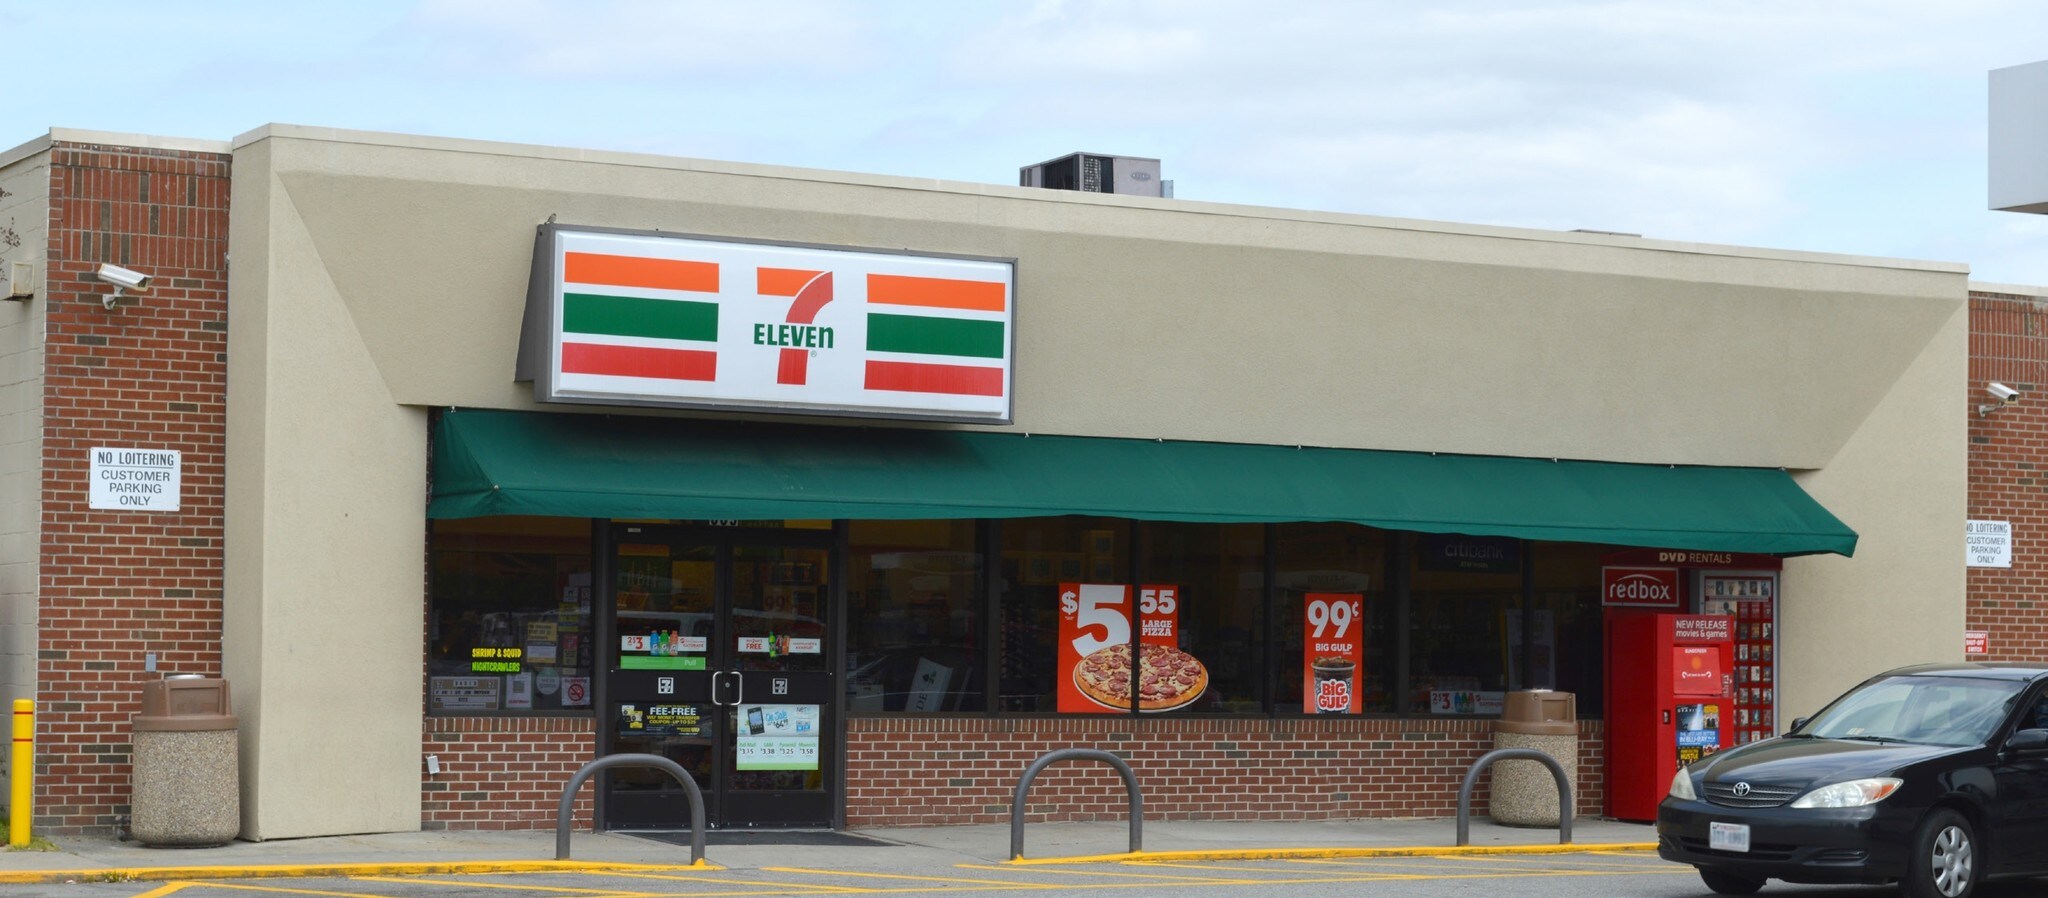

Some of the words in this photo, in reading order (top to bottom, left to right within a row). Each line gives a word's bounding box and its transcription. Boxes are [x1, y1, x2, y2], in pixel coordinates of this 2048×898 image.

[757, 266, 833, 386] 7
[98, 451, 113, 464] NO
[119, 452, 174, 466] LOITERING
[101, 470, 170, 481] CUSTOMER
[109, 482, 162, 493] PARKING
[119, 495, 151, 506] ONLY
[1976, 523, 2008, 533] LOITERING
[1966, 536, 2006, 545] CUSTOMER
[1444, 541, 1504, 560] citibank
[1971, 546, 2002, 555] PARKING
[1659, 552, 1687, 563] DVD
[1689, 553, 1732, 564] RENTALS
[1977, 555, 1996, 563] ONLY
[1609, 580, 1671, 600] redbox
[1140, 589, 1176, 614] 55
[1142, 619, 1172, 628] LARGE
[1676, 620, 1694, 629] NEW
[1695, 620, 1728, 630] RELEASE
[1142, 628, 1172, 636] PIZZA
[1700, 629, 1705, 638] &
[1706, 631, 1728, 639] games
[1330, 643, 1352, 652] GULP
[472, 648, 496, 658] SHRIMP
[497, 648, 502, 658] &
[503, 648, 522, 658] SQUID
[472, 662, 520, 672] NIGHTCRAWLERS
[1319, 695, 1349, 708] GULP
[650, 707, 697, 715] FEE-FREE
